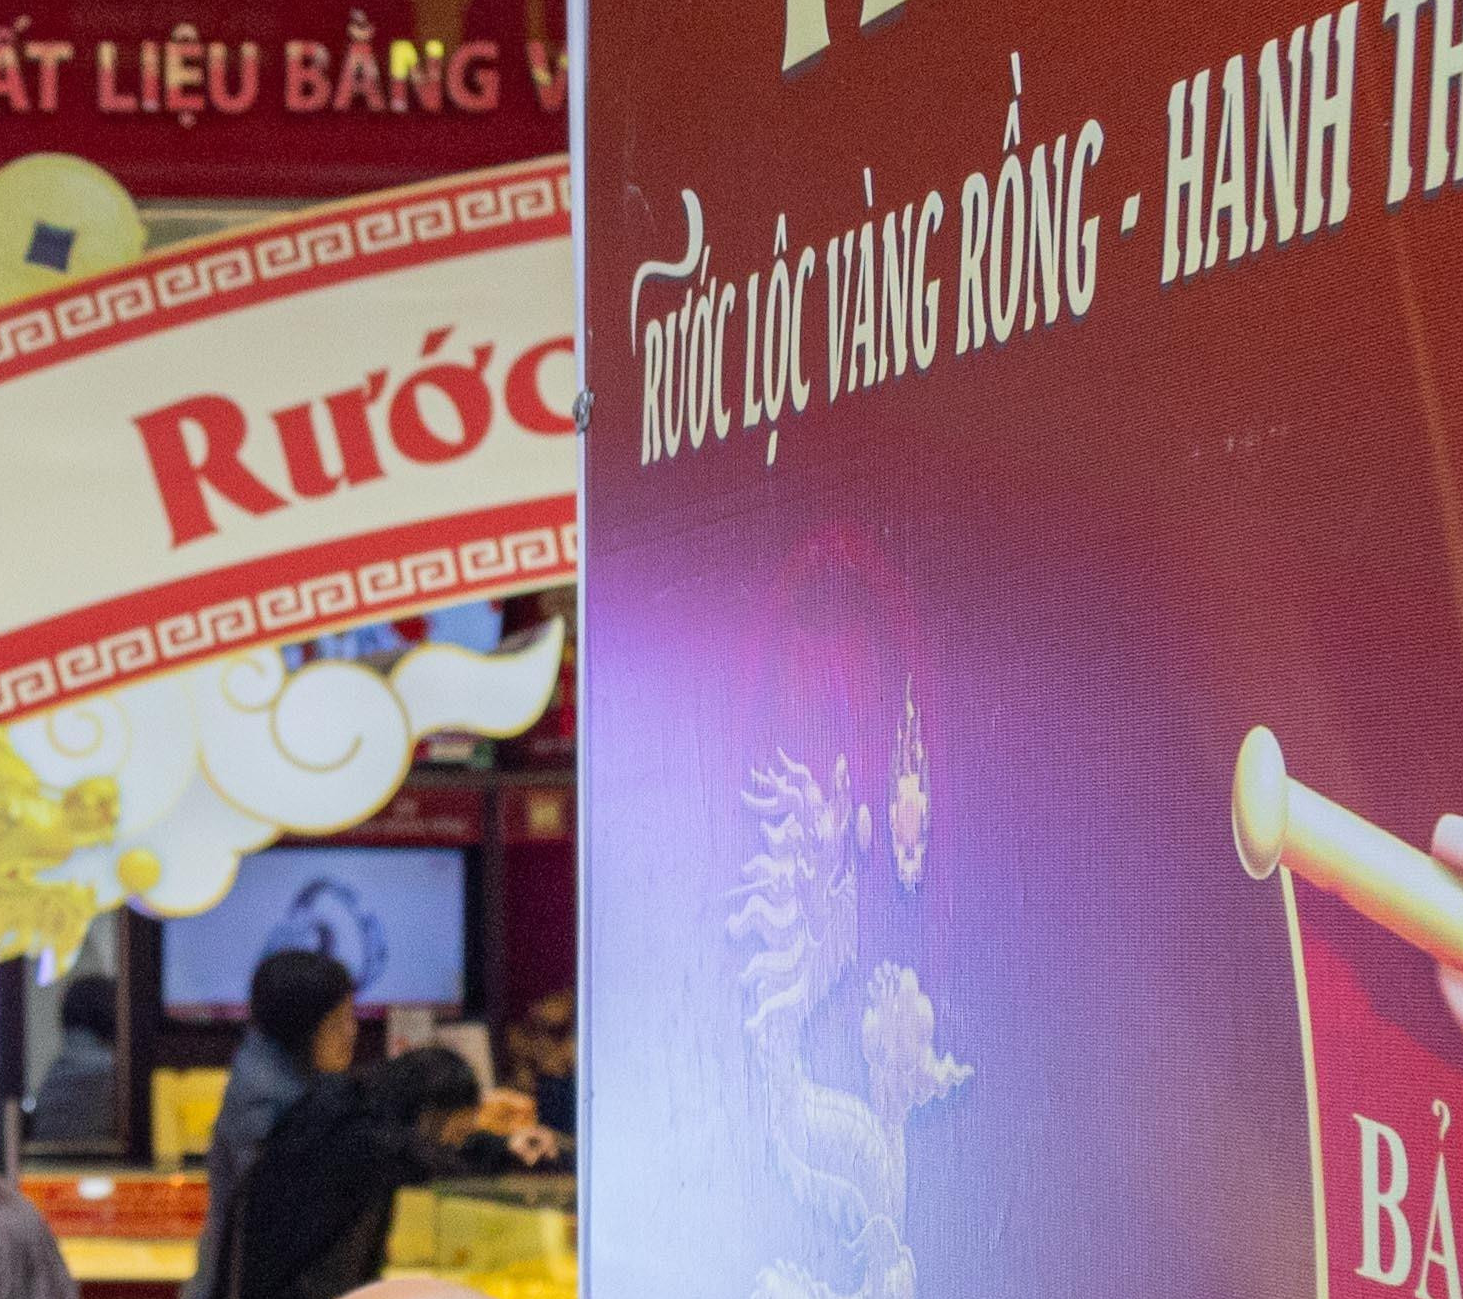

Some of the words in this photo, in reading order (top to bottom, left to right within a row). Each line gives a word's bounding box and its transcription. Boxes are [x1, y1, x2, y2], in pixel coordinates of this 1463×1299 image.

[97, 22, 260, 128] LIỆU
[284, 7, 500, 113] BẰNG
[633, 198, 734, 466] RƯỚC
[742, 213, 818, 466] LỘC
[823, 166, 943, 404] VÀNG
[956, 51, 1106, 354] RỒNG
[1161, 1, 1361, 284] HANH
